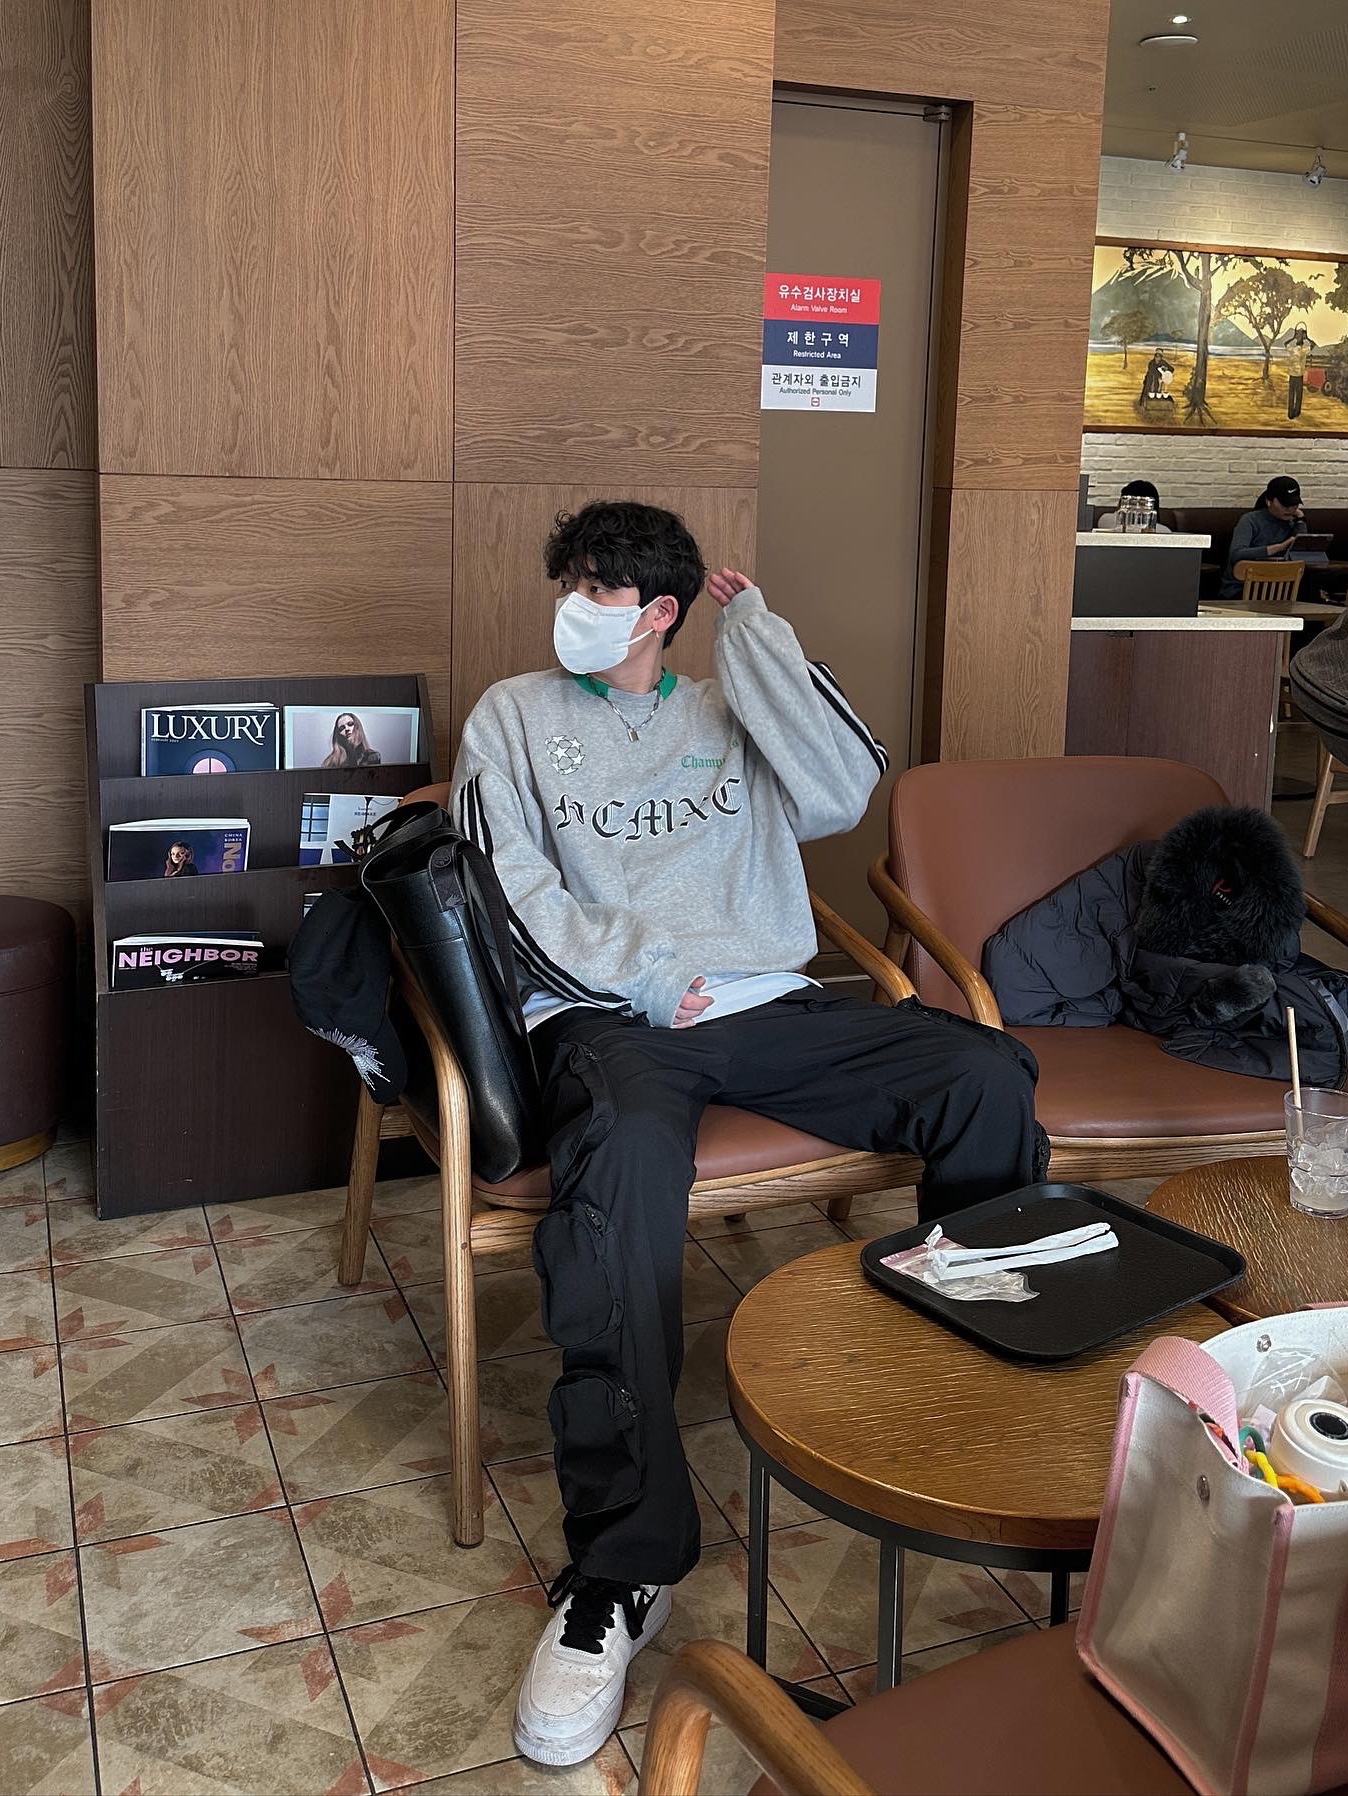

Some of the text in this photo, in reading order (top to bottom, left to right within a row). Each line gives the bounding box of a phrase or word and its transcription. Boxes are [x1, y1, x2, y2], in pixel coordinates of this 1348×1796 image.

[778, 284, 861, 303] 유수검사장치실
[790, 304, 848, 314] Alarm Valve Room
[793, 350, 842, 359] Restricted Area
[771, 372, 861, 388] 관계자외 출입금지
[779, 387, 852, 397] Authorized Personal Only
[151, 713, 271, 745] LUXURY
[681, 755, 726, 770] Champ
[118, 948, 258, 968] NEIGHBOR
